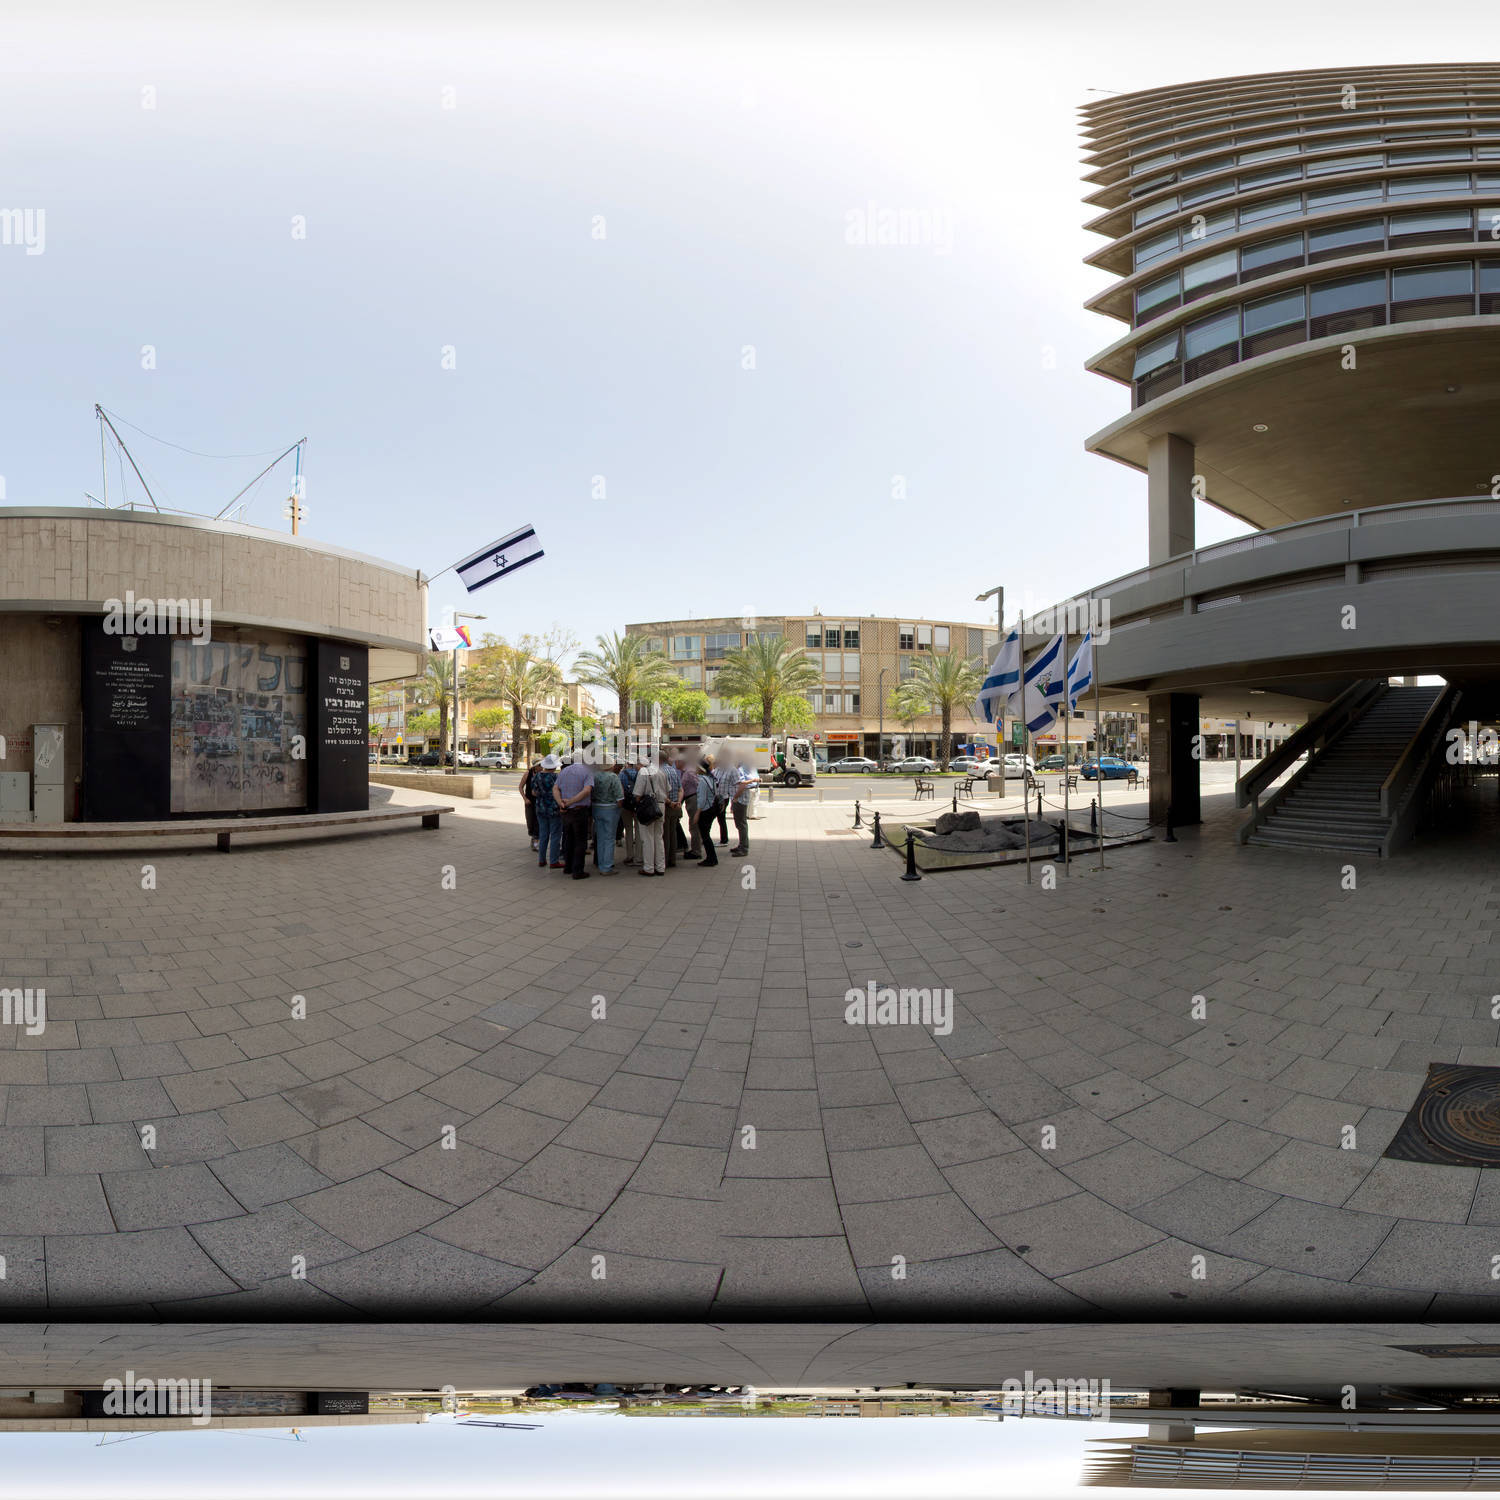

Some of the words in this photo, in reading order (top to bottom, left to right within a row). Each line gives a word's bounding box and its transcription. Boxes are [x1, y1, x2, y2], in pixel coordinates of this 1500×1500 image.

[328, 676, 337, 684] זה
[339, 677, 361, 686] במקום
[336, 687, 354, 696] נרצח
[324, 697, 343, 707] רבין
[332, 716, 357, 725] במאבק
[327, 724, 351, 734] השלום
[352, 725, 362, 735] על
